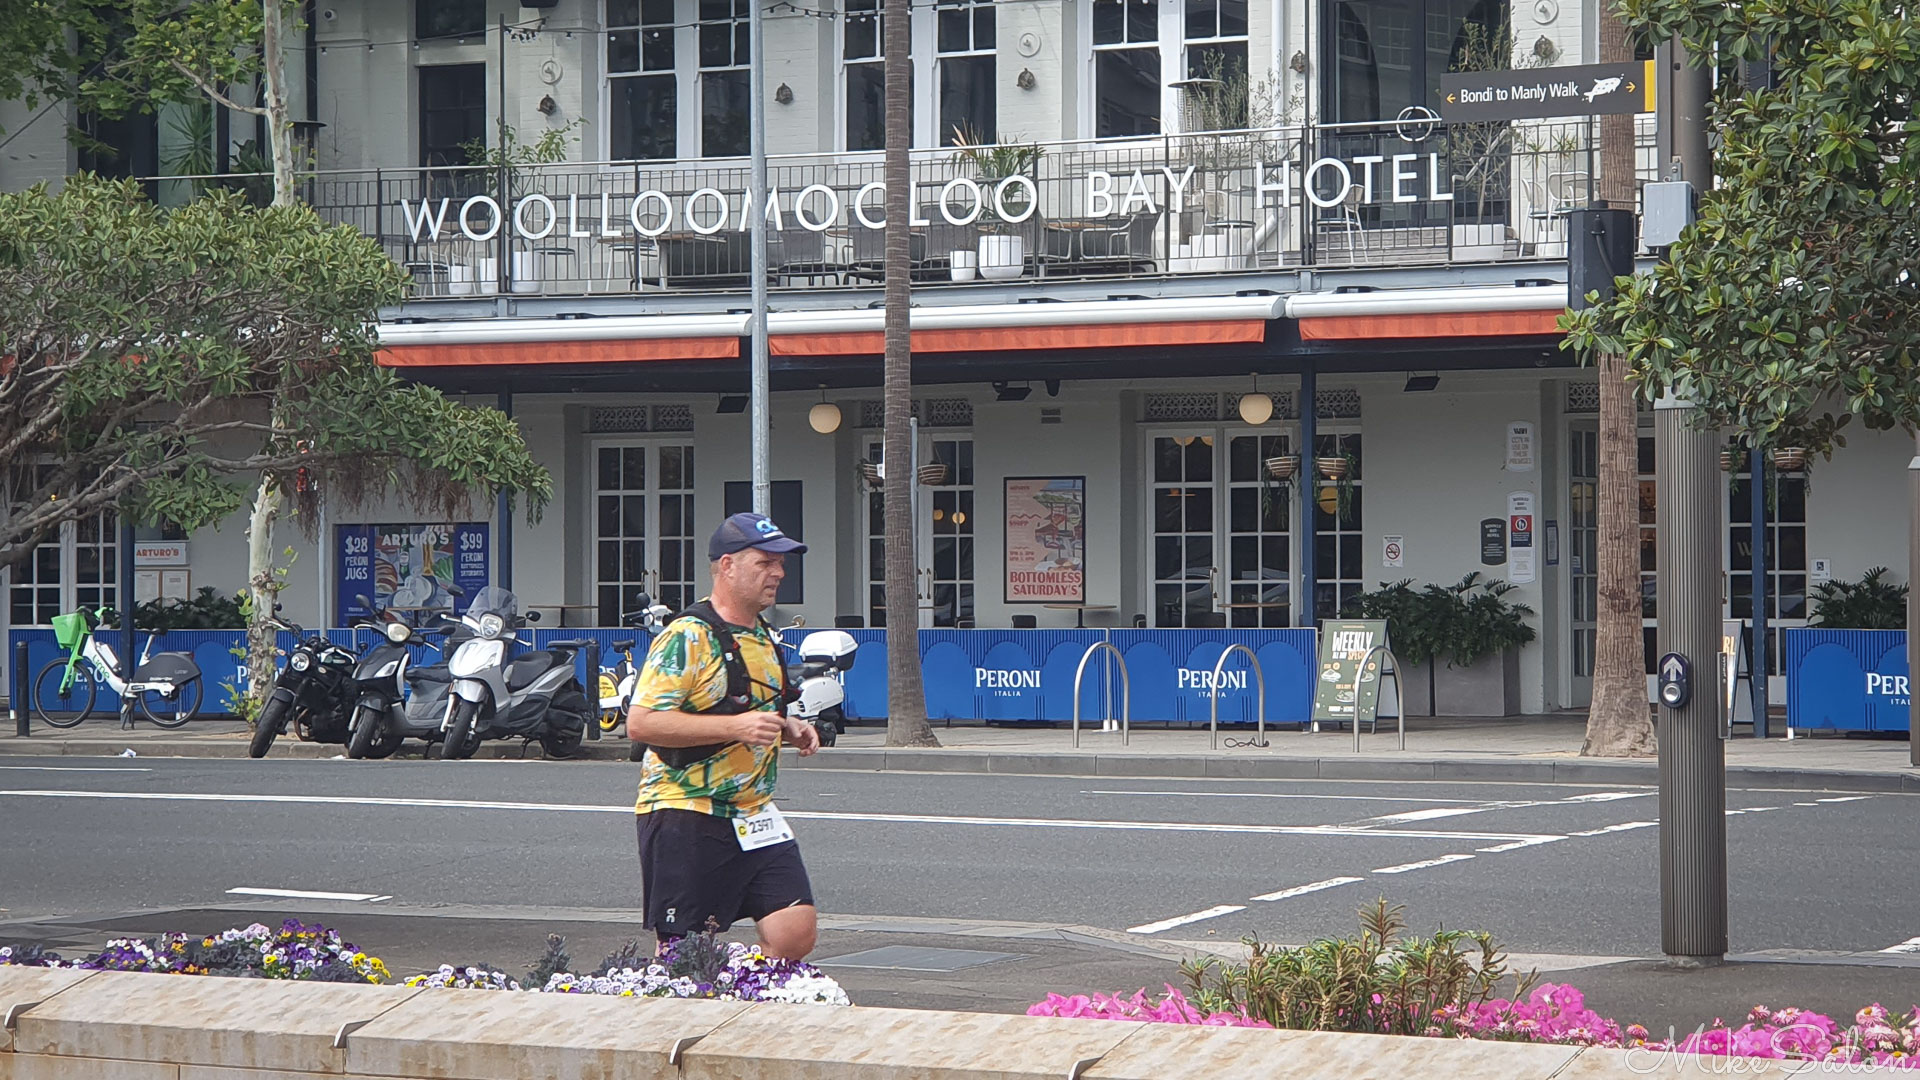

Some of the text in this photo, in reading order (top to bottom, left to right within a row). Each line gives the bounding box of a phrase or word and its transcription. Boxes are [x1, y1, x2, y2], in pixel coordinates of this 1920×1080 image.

[1460, 81, 1579, 103] Bondi to Manly Walk
[401, 152, 1454, 244] WOOLLOOMOOLOO BAY HOTEL
[345, 535, 368, 555] $28
[381, 532, 449, 546] ARTURO'S
[460, 531, 483, 551] $99
[136, 547, 180, 557] ARTURO'S
[344, 556, 369, 567] PERONI
[460, 552, 484, 562] PERONI
[345, 567, 368, 580] JUGS
[1010, 571, 1081, 584] BOTTOMLESS
[1013, 584, 1078, 596] SATURDAY'S
[1332, 631, 1373, 652] WEEKLY
[92, 654, 110, 680] Lime
[975, 668, 1041, 688] PERONI
[1178, 668, 1247, 689] PERONI
[738, 817, 775, 836] C 2397
